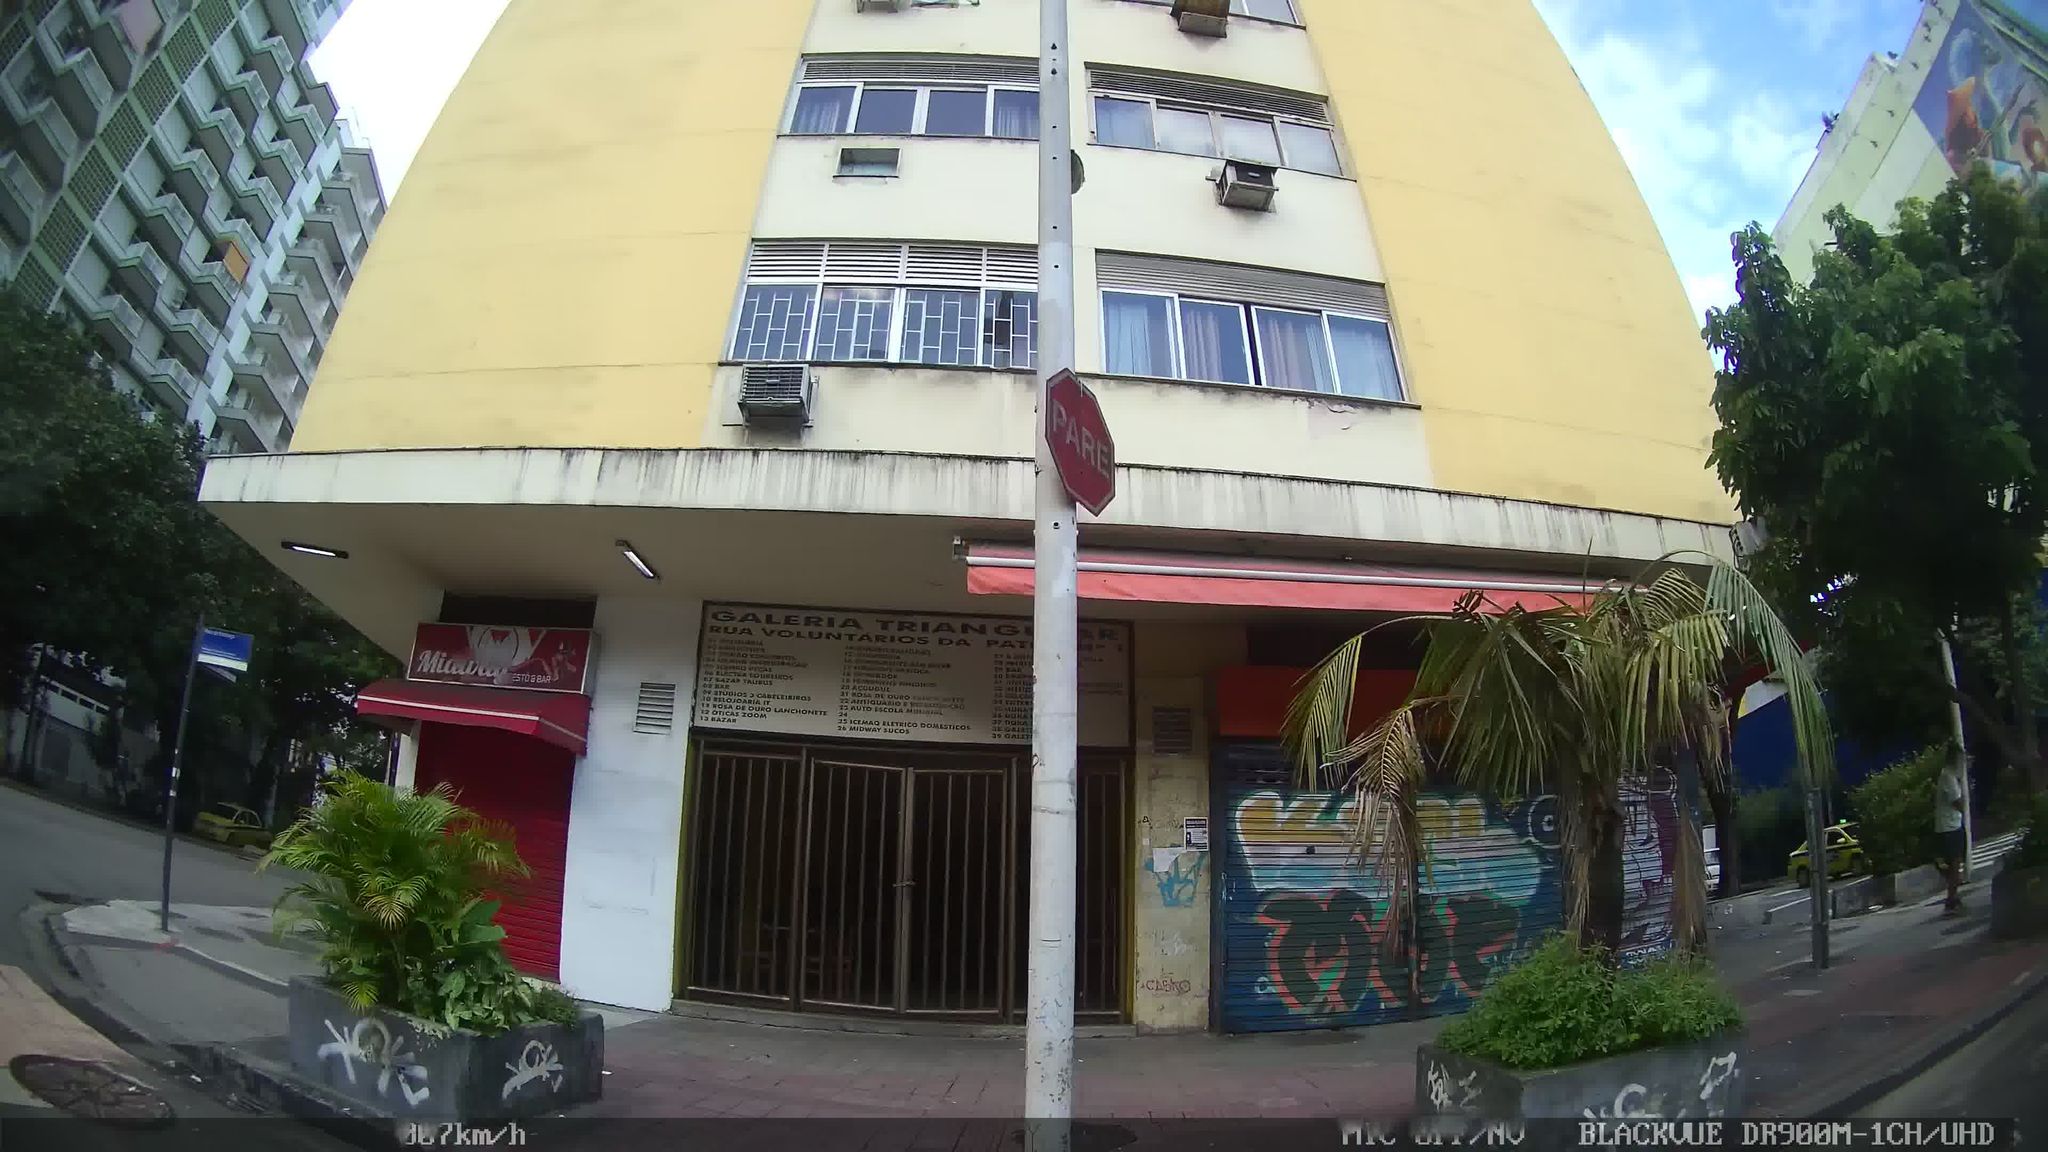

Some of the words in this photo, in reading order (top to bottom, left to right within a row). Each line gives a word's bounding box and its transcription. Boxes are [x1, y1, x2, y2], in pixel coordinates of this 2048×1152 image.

[1052, 399, 1110, 480] PARE
[711, 611, 864, 629] GALERIA
[709, 625, 753, 636] RUA
[938, 637, 971, 647] DA
[774, 707, 829, 716] LANCHONETE
